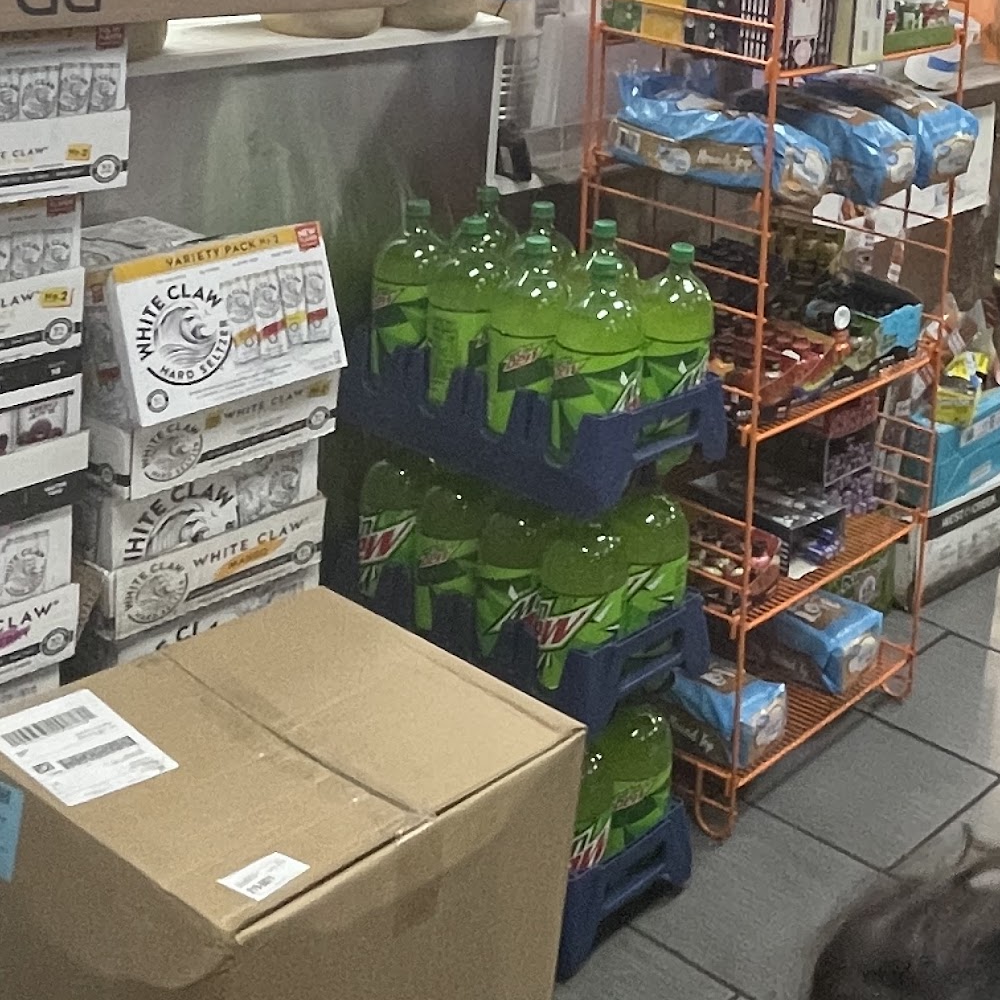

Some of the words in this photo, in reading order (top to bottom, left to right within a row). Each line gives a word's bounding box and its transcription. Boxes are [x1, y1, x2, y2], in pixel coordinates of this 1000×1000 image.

[12, 147, 44, 158] CLAW
[165, 248, 219, 268] VARIETY
[224, 239, 255, 256] PACK
[136, 294, 166, 361] WHITE
[167, 283, 223, 308] CLAW
[160, 364, 196, 381] HARD
[199, 319, 230, 374] SELTZER
[224, 401, 266, 419] WHITE
[270, 388, 304, 408] CLAW
[163, 422, 199, 435] CLAW
[170, 480, 235, 508] CLAW
[193, 538, 250, 568] WHITE
[256, 520, 303, 546] CLAW
[150, 561, 186, 573] CLAW
